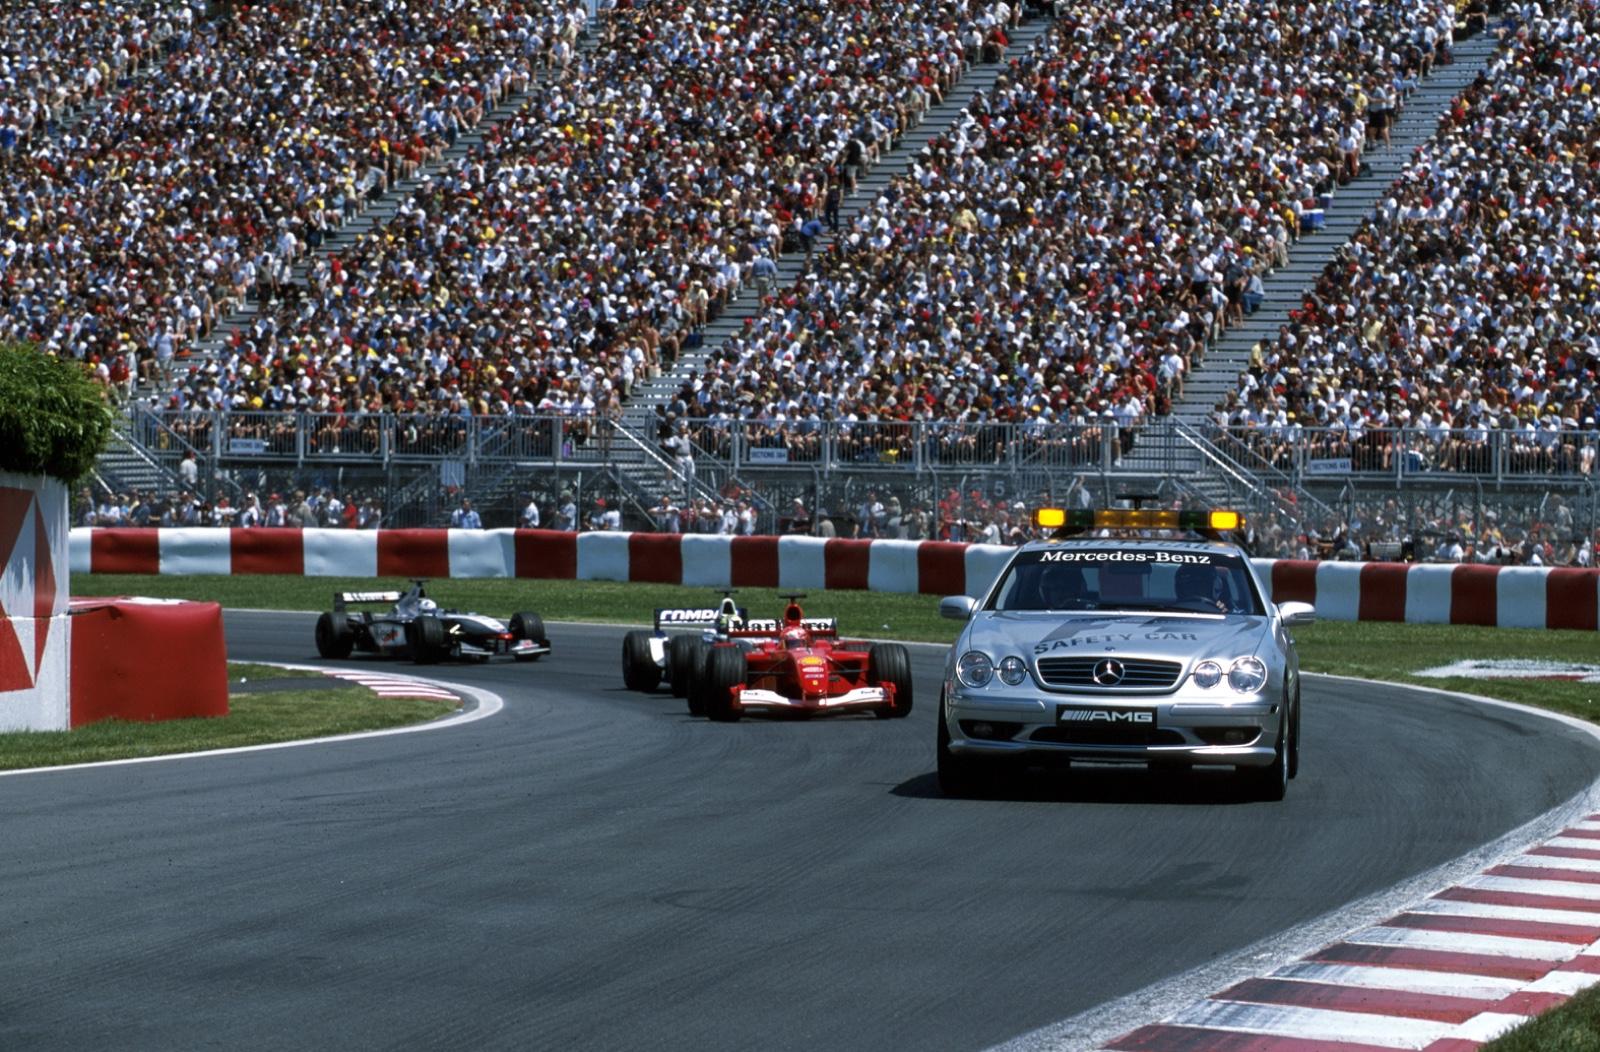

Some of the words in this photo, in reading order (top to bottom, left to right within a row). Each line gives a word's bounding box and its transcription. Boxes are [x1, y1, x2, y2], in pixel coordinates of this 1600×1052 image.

[1039, 551, 1211, 565] Mercedes-Benz
[1034, 633, 1133, 655] SAFETY
[1144, 632, 1198, 641] CAR
[1088, 710, 1153, 723] AMG
